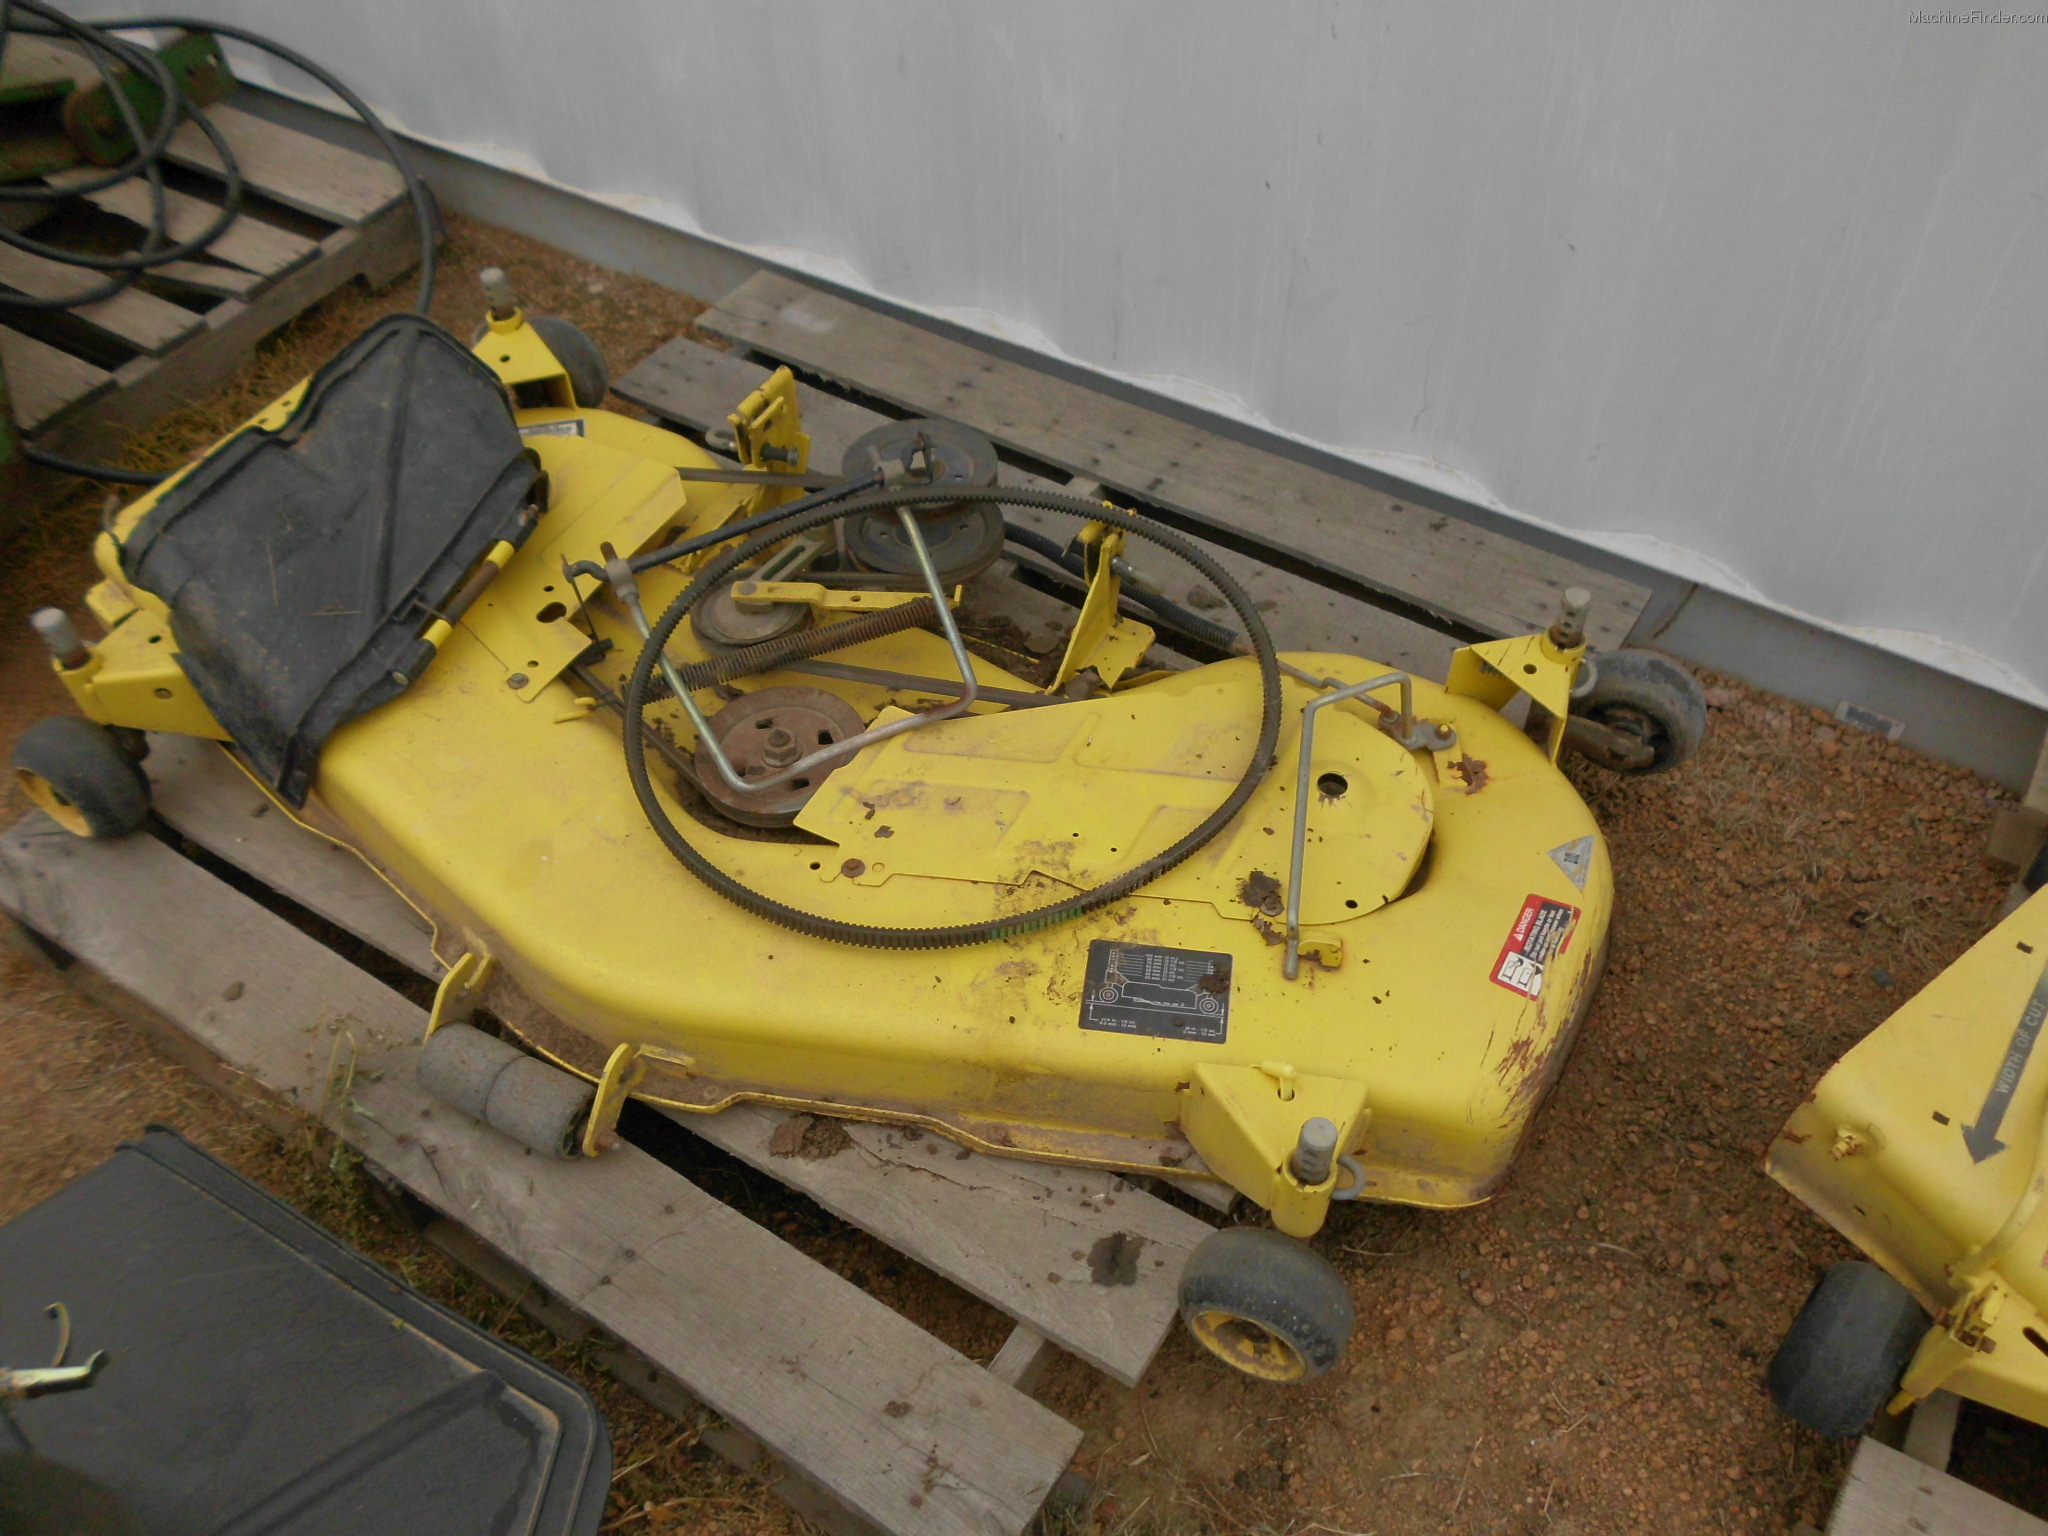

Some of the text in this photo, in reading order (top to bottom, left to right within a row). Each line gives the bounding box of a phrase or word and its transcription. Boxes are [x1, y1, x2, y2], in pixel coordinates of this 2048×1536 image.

[1516, 907, 1534, 933] DANGER
[1535, 909, 1547, 926] BLADE
[1996, 998, 2045, 1093] WIDTH OF CUT
